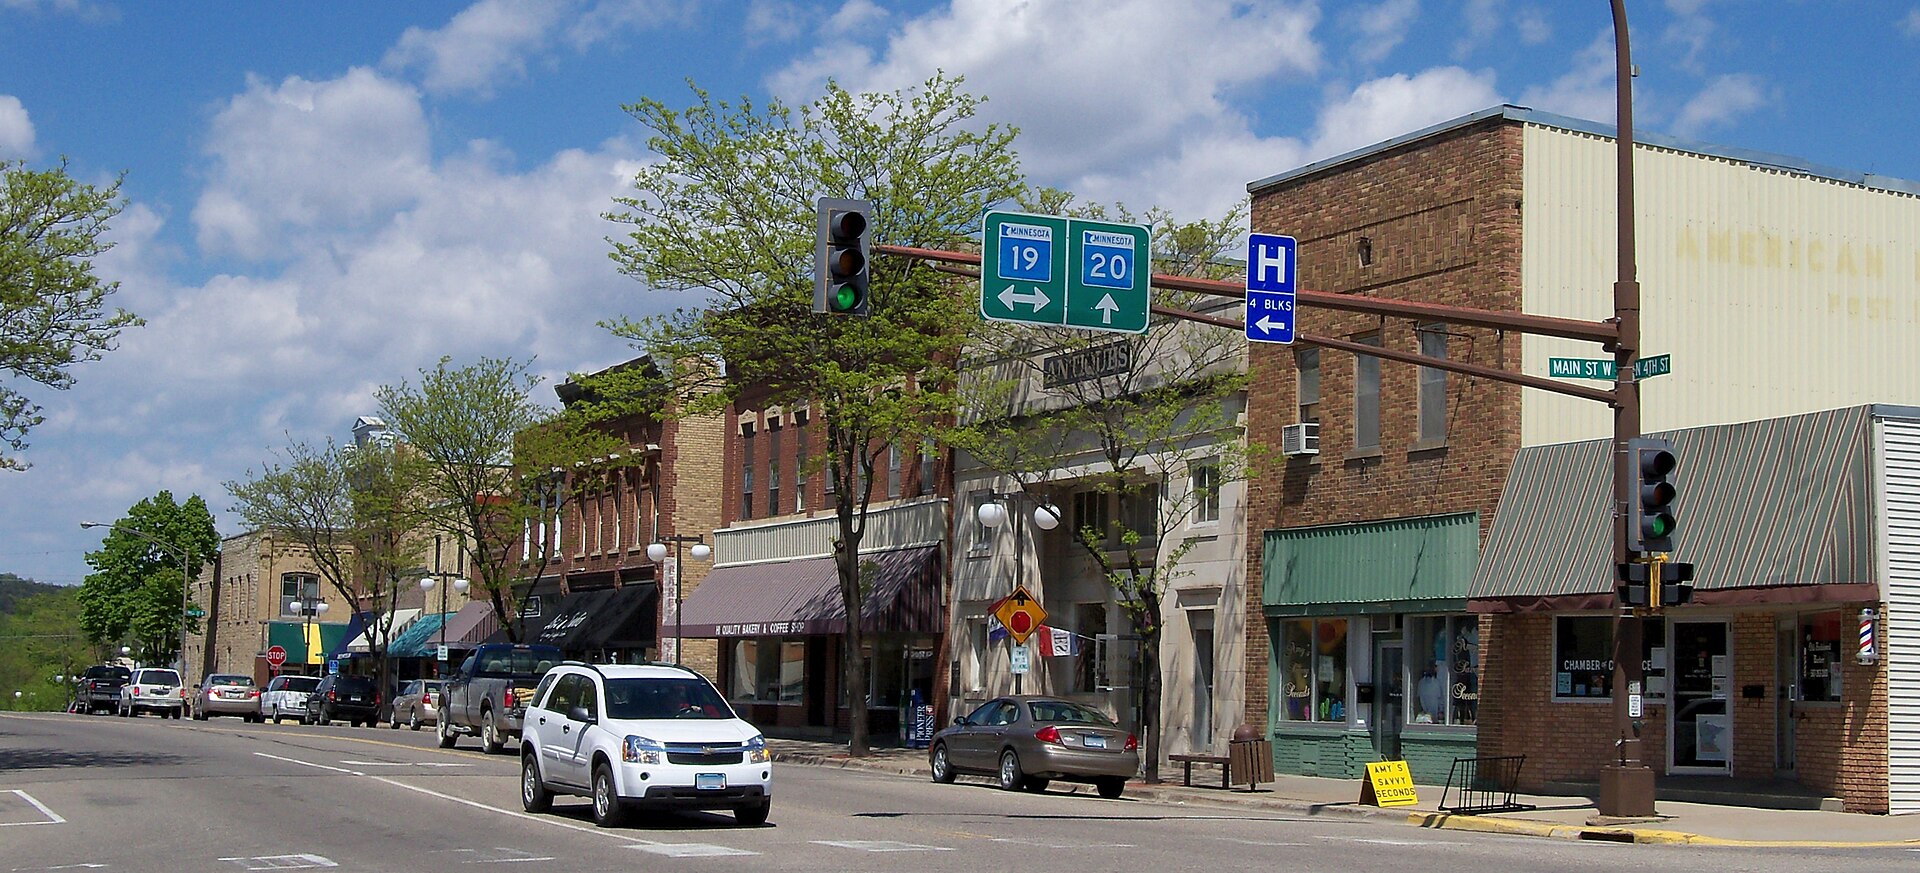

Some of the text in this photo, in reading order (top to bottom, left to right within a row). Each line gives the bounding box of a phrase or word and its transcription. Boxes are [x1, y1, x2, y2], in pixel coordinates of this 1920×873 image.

[1010, 226, 1050, 238] MINNESOTA
[1091, 234, 1133, 246] MINNESOTA
[1012, 245, 1039, 271] 19
[1676, 226, 1884, 281] AMERICAN
[1090, 252, 1126, 280] 20
[1257, 244, 1286, 284] H
[1249, 298, 1292, 312] 4 BLKS
[1553, 360, 1612, 376] MAIN ST W
[1635, 357, 1669, 376] N 4TH ST
[722, 625, 740, 635] QUALITY
[742, 624, 760, 634] BAKERY
[763, 623, 767, 634] &
[770, 622, 789, 633] COFFEE
[791, 622, 804, 633] SHOP
[268, 652, 285, 660] STOP
[1564, 660, 1600, 670] CHAMBER
[916, 705, 925, 741] PIONEER
[925, 715, 934, 741] PRESS
[1378, 777, 1406, 786] SAVVY
[1376, 788, 1416, 798] SECONDS
